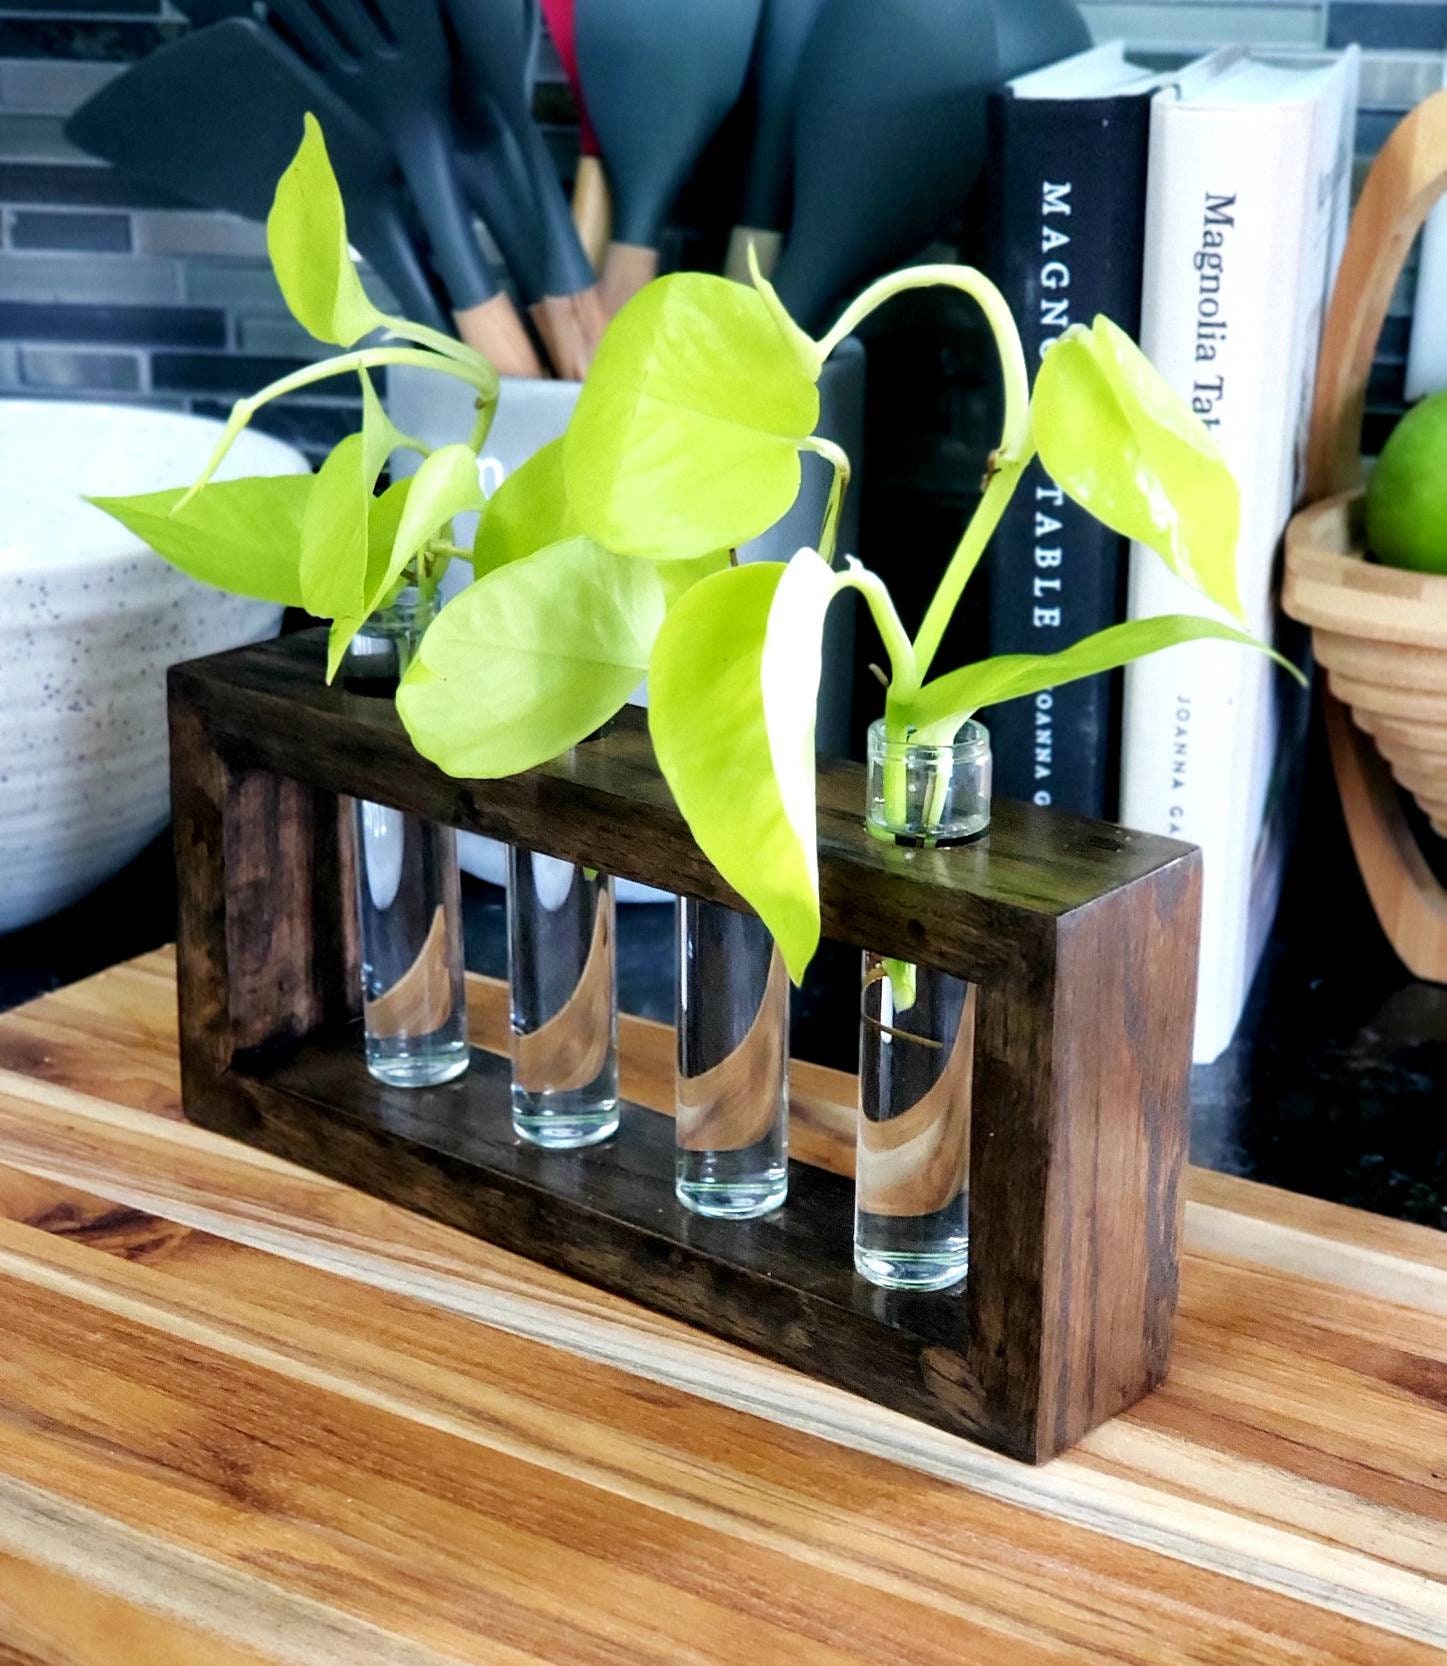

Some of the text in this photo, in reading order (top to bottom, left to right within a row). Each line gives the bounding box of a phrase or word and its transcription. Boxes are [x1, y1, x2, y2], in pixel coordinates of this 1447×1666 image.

[1193, 192, 1236, 362] Magnolia
[1034, 485, 1063, 628] TABLE
[1034, 687, 1053, 779] OANNA
[1171, 695, 1191, 790] JOANNA
